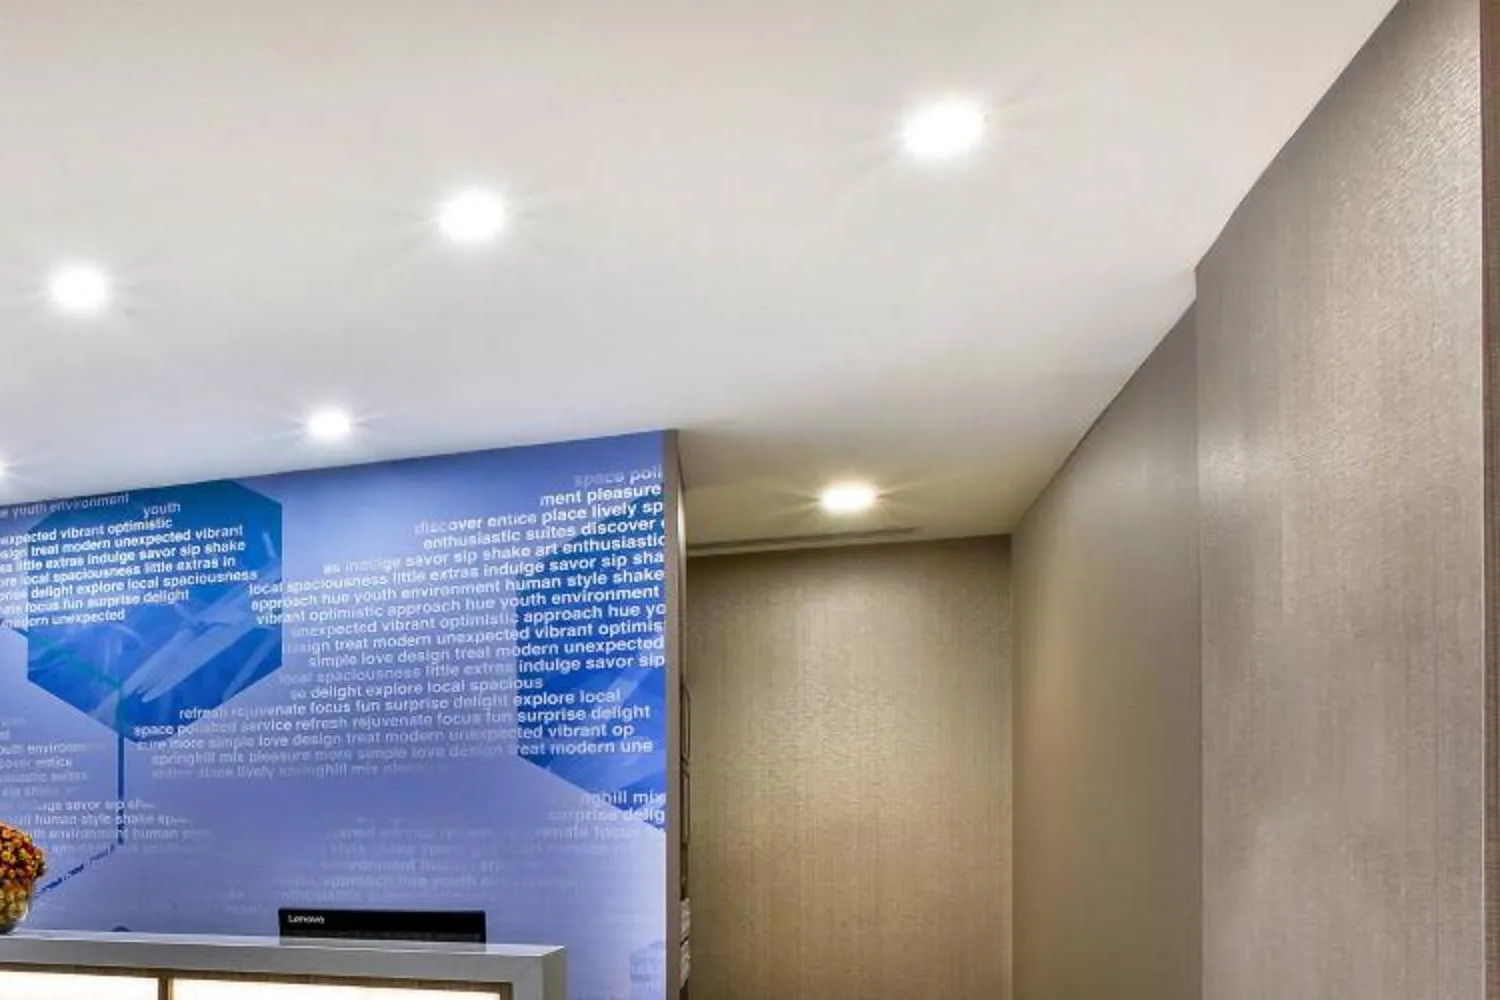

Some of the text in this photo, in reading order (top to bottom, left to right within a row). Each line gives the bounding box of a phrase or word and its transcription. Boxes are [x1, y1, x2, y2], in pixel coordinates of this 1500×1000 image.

[143, 501, 181, 518] youth
[540, 484, 662, 506] ment pleasure
[59, 517, 173, 539] vibrant optimistic
[487, 512, 537, 528] entice
[542, 508, 587, 527] place
[592, 501, 636, 518] lively
[32, 544, 59, 557] treat
[62, 540, 111, 553] modern
[114, 528, 191, 548] unexpected
[195, 523, 244, 539] vibrant
[423, 519, 656, 548] enthusiastic suites discover
[46, 557, 84, 569] extras
[87, 550, 135, 565] indulge
[139, 548, 176, 560] savor
[179, 543, 200, 558] sip
[204, 539, 246, 554] shake
[405, 554, 450, 567] savor
[453, 549, 477, 565] sip
[483, 544, 531, 561] shake
[535, 542, 559, 556] art
[53, 565, 141, 584] spaciousness
[144, 560, 173, 574] little
[176, 558, 219, 571] extras
[223, 554, 236, 567] in
[250, 580, 283, 594] local
[287, 574, 388, 594] spaciousness
[393, 568, 426, 583] little
[429, 567, 479, 581] extras
[483, 560, 545, 577] indulge
[549, 558, 596, 572] savor
[601, 552, 627, 570] sip
[32, 571, 258, 600] delight explore local spaciousness
[87, 594, 141, 610] surprise
[143, 589, 190, 605] delight
[251, 568, 665, 613] approach hue youth environment human style shake
[256, 585, 659, 624] vibrant optimistic approach hue youth environment
[381, 617, 435, 632] vibrant
[439, 610, 519, 631] optimistic
[524, 604, 602, 626] approach
[607, 603, 640, 617] hue
[336, 636, 369, 649] treat
[373, 633, 431, 648] modern
[436, 626, 530, 645] unexpected
[535, 623, 593, 639] vibrant
[308, 634, 664, 669] simple love design treat modern unexpected
[318, 652, 665, 685] spaciousness little extras indulge savor sip
[311, 676, 544, 700] delight explore local spacious
[179, 688, 621, 719] refresh rejuvenate focus fun surprise delight explore local
[133, 725, 173, 738] space
[241, 718, 292, 732] service
[296, 715, 348, 730] refresh
[352, 713, 433, 730] rejuvenate
[437, 711, 481, 725] focus
[486, 709, 512, 723] fun
[517, 707, 587, 725] surprise
[591, 704, 651, 722] delight
[259, 734, 289, 747] love
[292, 732, 341, 748] design
[347, 732, 381, 744] treat
[385, 729, 444, 743] modern
[547, 723, 607, 738] vibrant
[611, 725, 635, 739] op
[550, 740, 615, 755] modern
[620, 742, 653, 753] une
[287, 914, 325, 925] Lenovo
